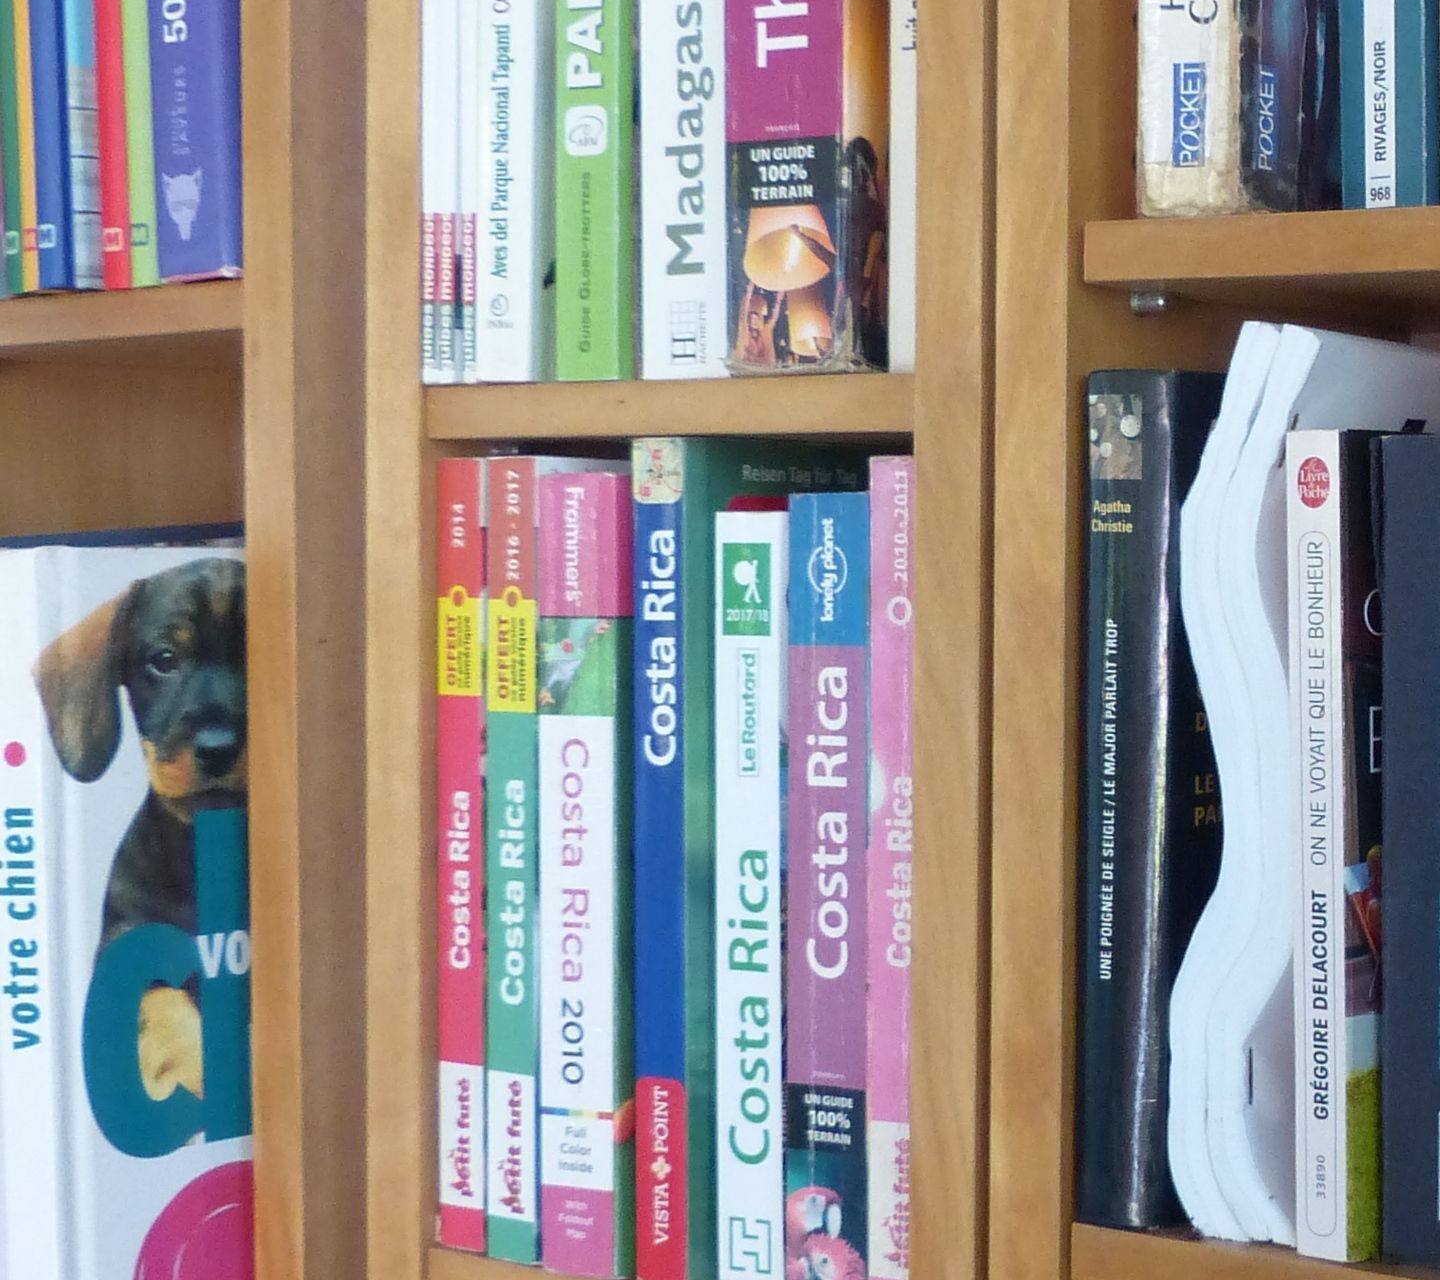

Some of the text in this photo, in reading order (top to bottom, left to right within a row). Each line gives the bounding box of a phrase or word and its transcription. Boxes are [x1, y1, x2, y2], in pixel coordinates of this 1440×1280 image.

[643, 529, 678, 767] Costa Rica
[0, 805, 42, 1050] votre chien
[447, 789, 472, 970] Costa Rica
[498, 778, 526, 1005] Costa Rica
[558, 737, 591, 1085] Costa Rica 2010
[806, 665, 850, 979] Costa Rica
[727, 848, 772, 1165] Costa Rica
[1309, 889, 1329, 1120] GRÉGOIRE DELACOURT
